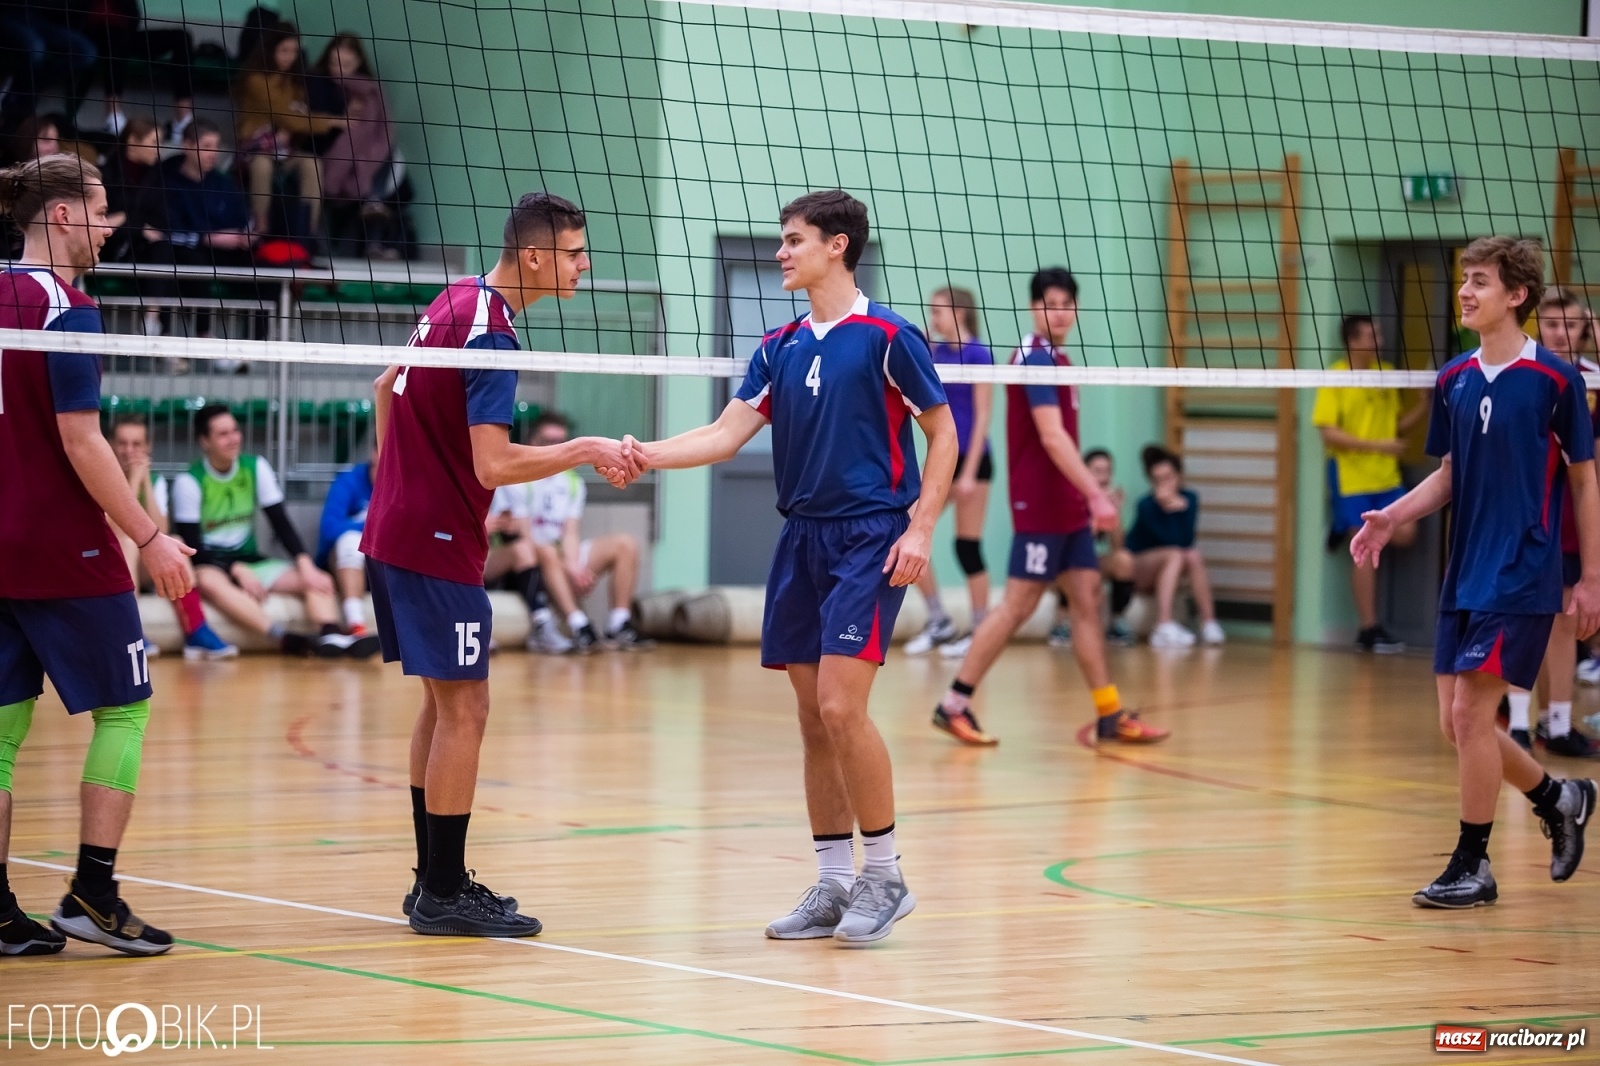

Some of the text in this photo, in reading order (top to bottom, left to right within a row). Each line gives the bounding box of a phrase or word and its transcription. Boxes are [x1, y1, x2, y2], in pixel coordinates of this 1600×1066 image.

[805, 355, 821, 396] 4
[1479, 395, 1492, 435] 9
[1025, 541, 1048, 575] 12
[455, 622, 481, 666] 15
